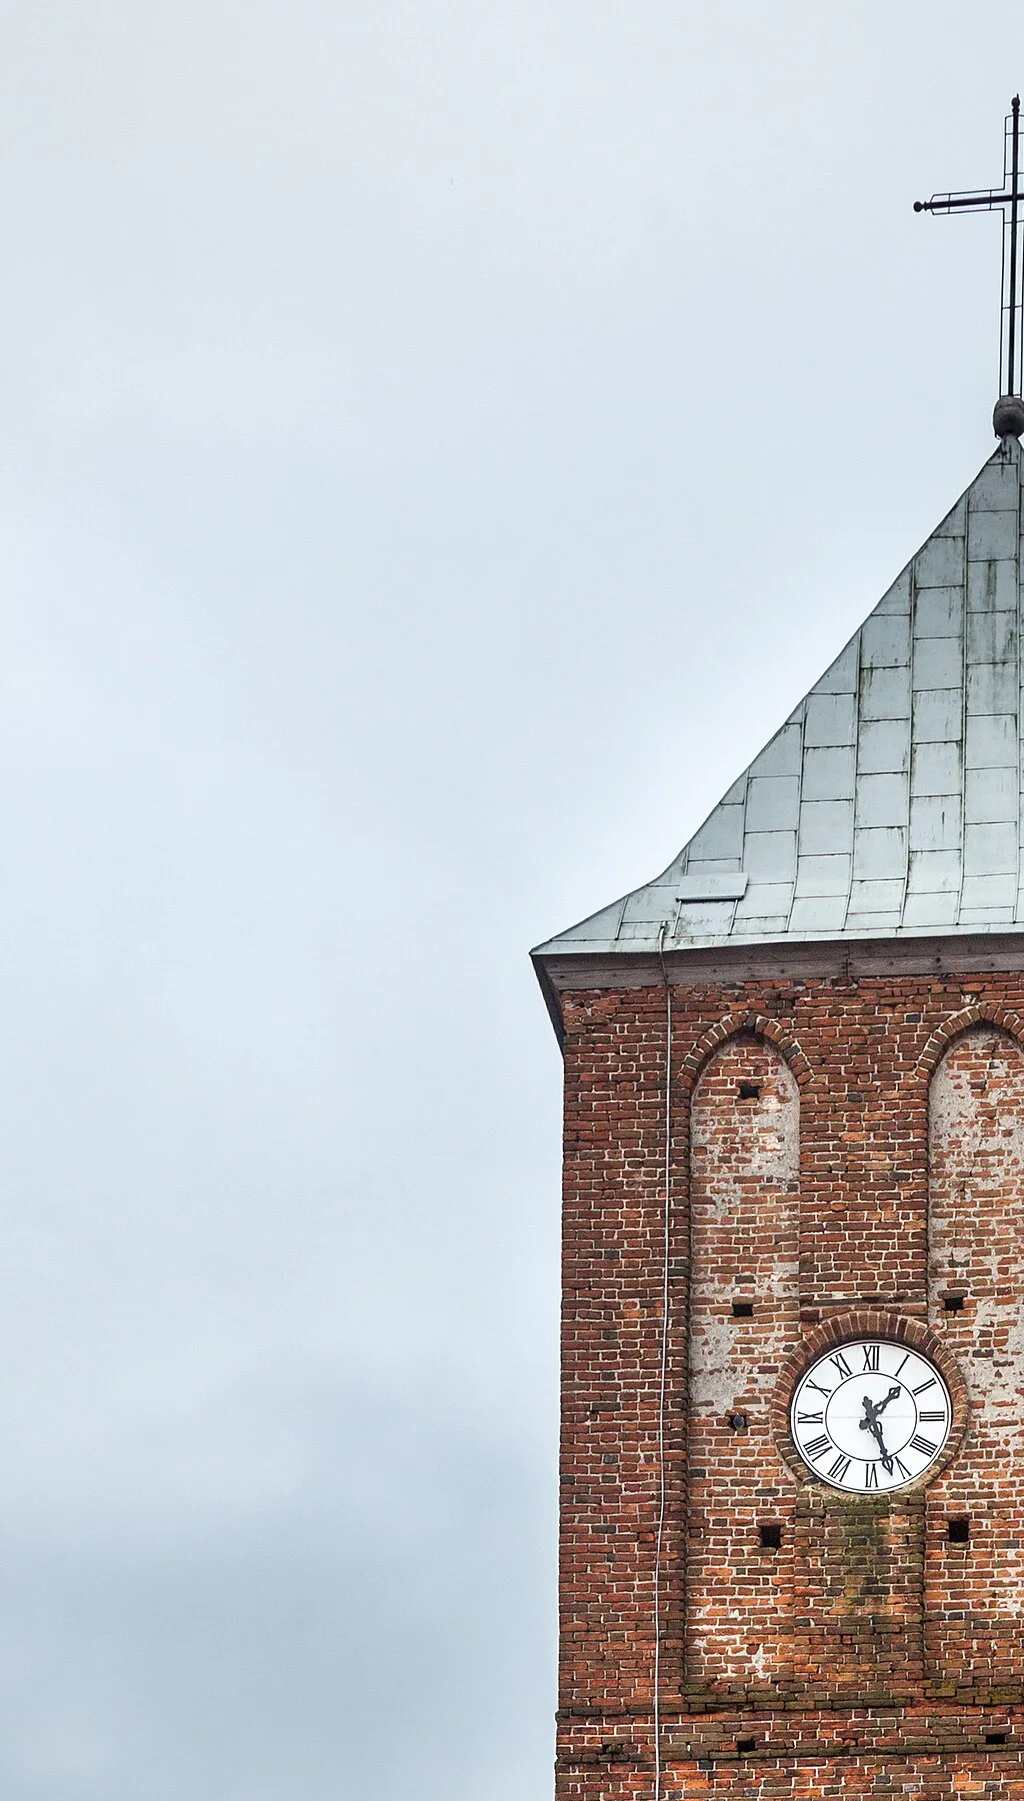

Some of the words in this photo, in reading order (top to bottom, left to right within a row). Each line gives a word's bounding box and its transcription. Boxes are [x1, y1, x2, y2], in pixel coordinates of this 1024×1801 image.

[829, 1353, 853, 1380] XI
[862, 1345, 880, 1371] XII
[894, 1354, 910, 1377] I
[806, 1379, 832, 1398] X
[912, 1377, 937, 1396] II
[797, 1411, 824, 1424] IX
[919, 1411, 945, 1422] III
[803, 1434, 833, 1462] VIII
[909, 1434, 939, 1458] IIII
[827, 1454, 852, 1482] VII
[864, 1463, 878, 1488] VI
[894, 1456, 912, 1479] V
